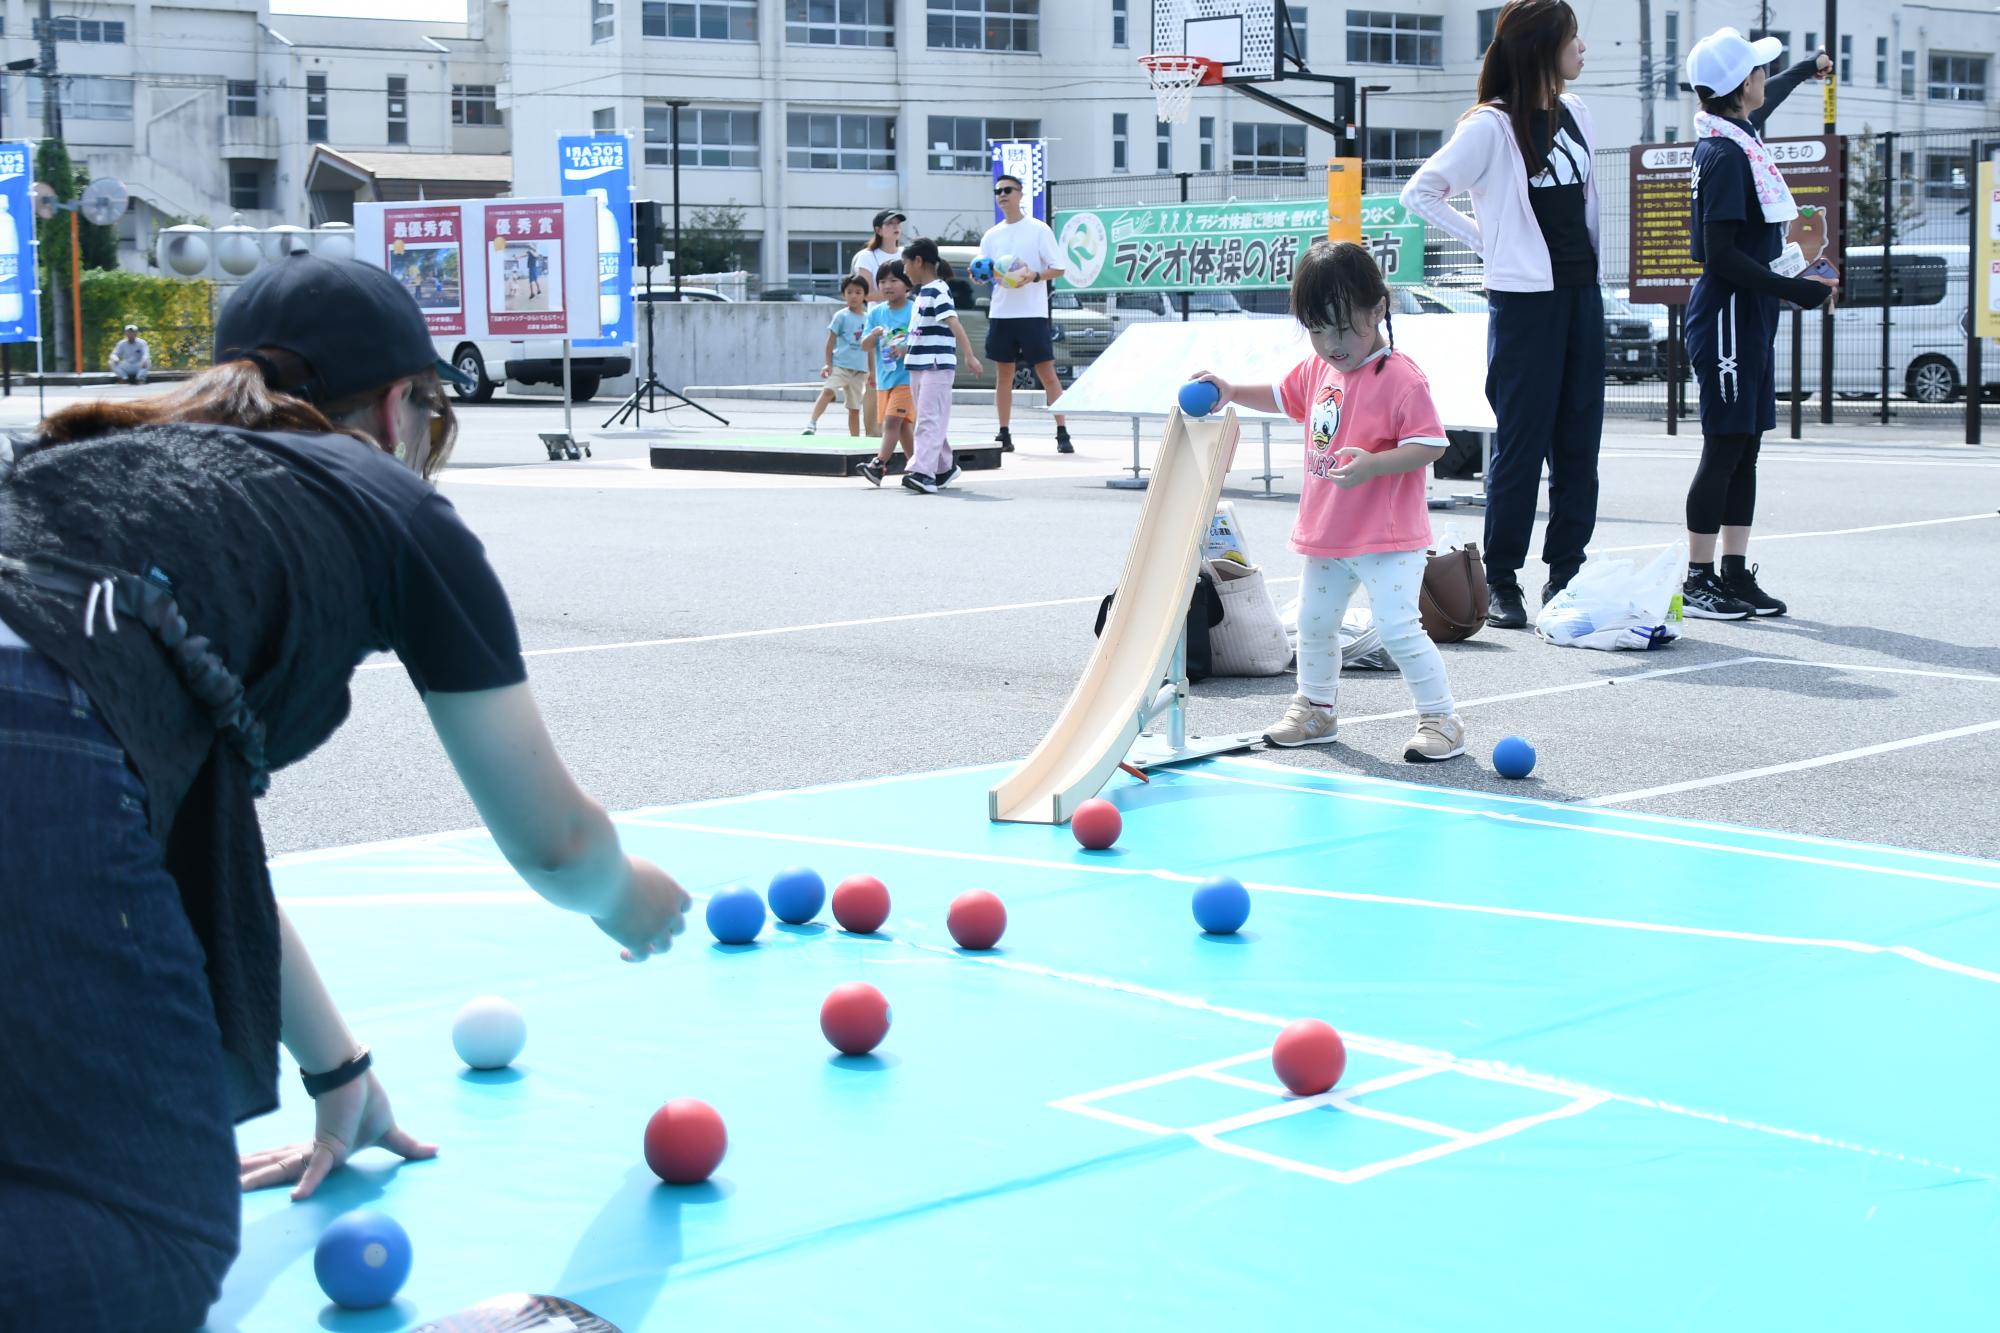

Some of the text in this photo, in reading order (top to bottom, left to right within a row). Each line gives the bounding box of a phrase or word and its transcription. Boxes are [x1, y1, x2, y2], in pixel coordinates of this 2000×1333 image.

[394, 220, 453, 238] 最優秀賞
[496, 217, 553, 235] 優秀賞
